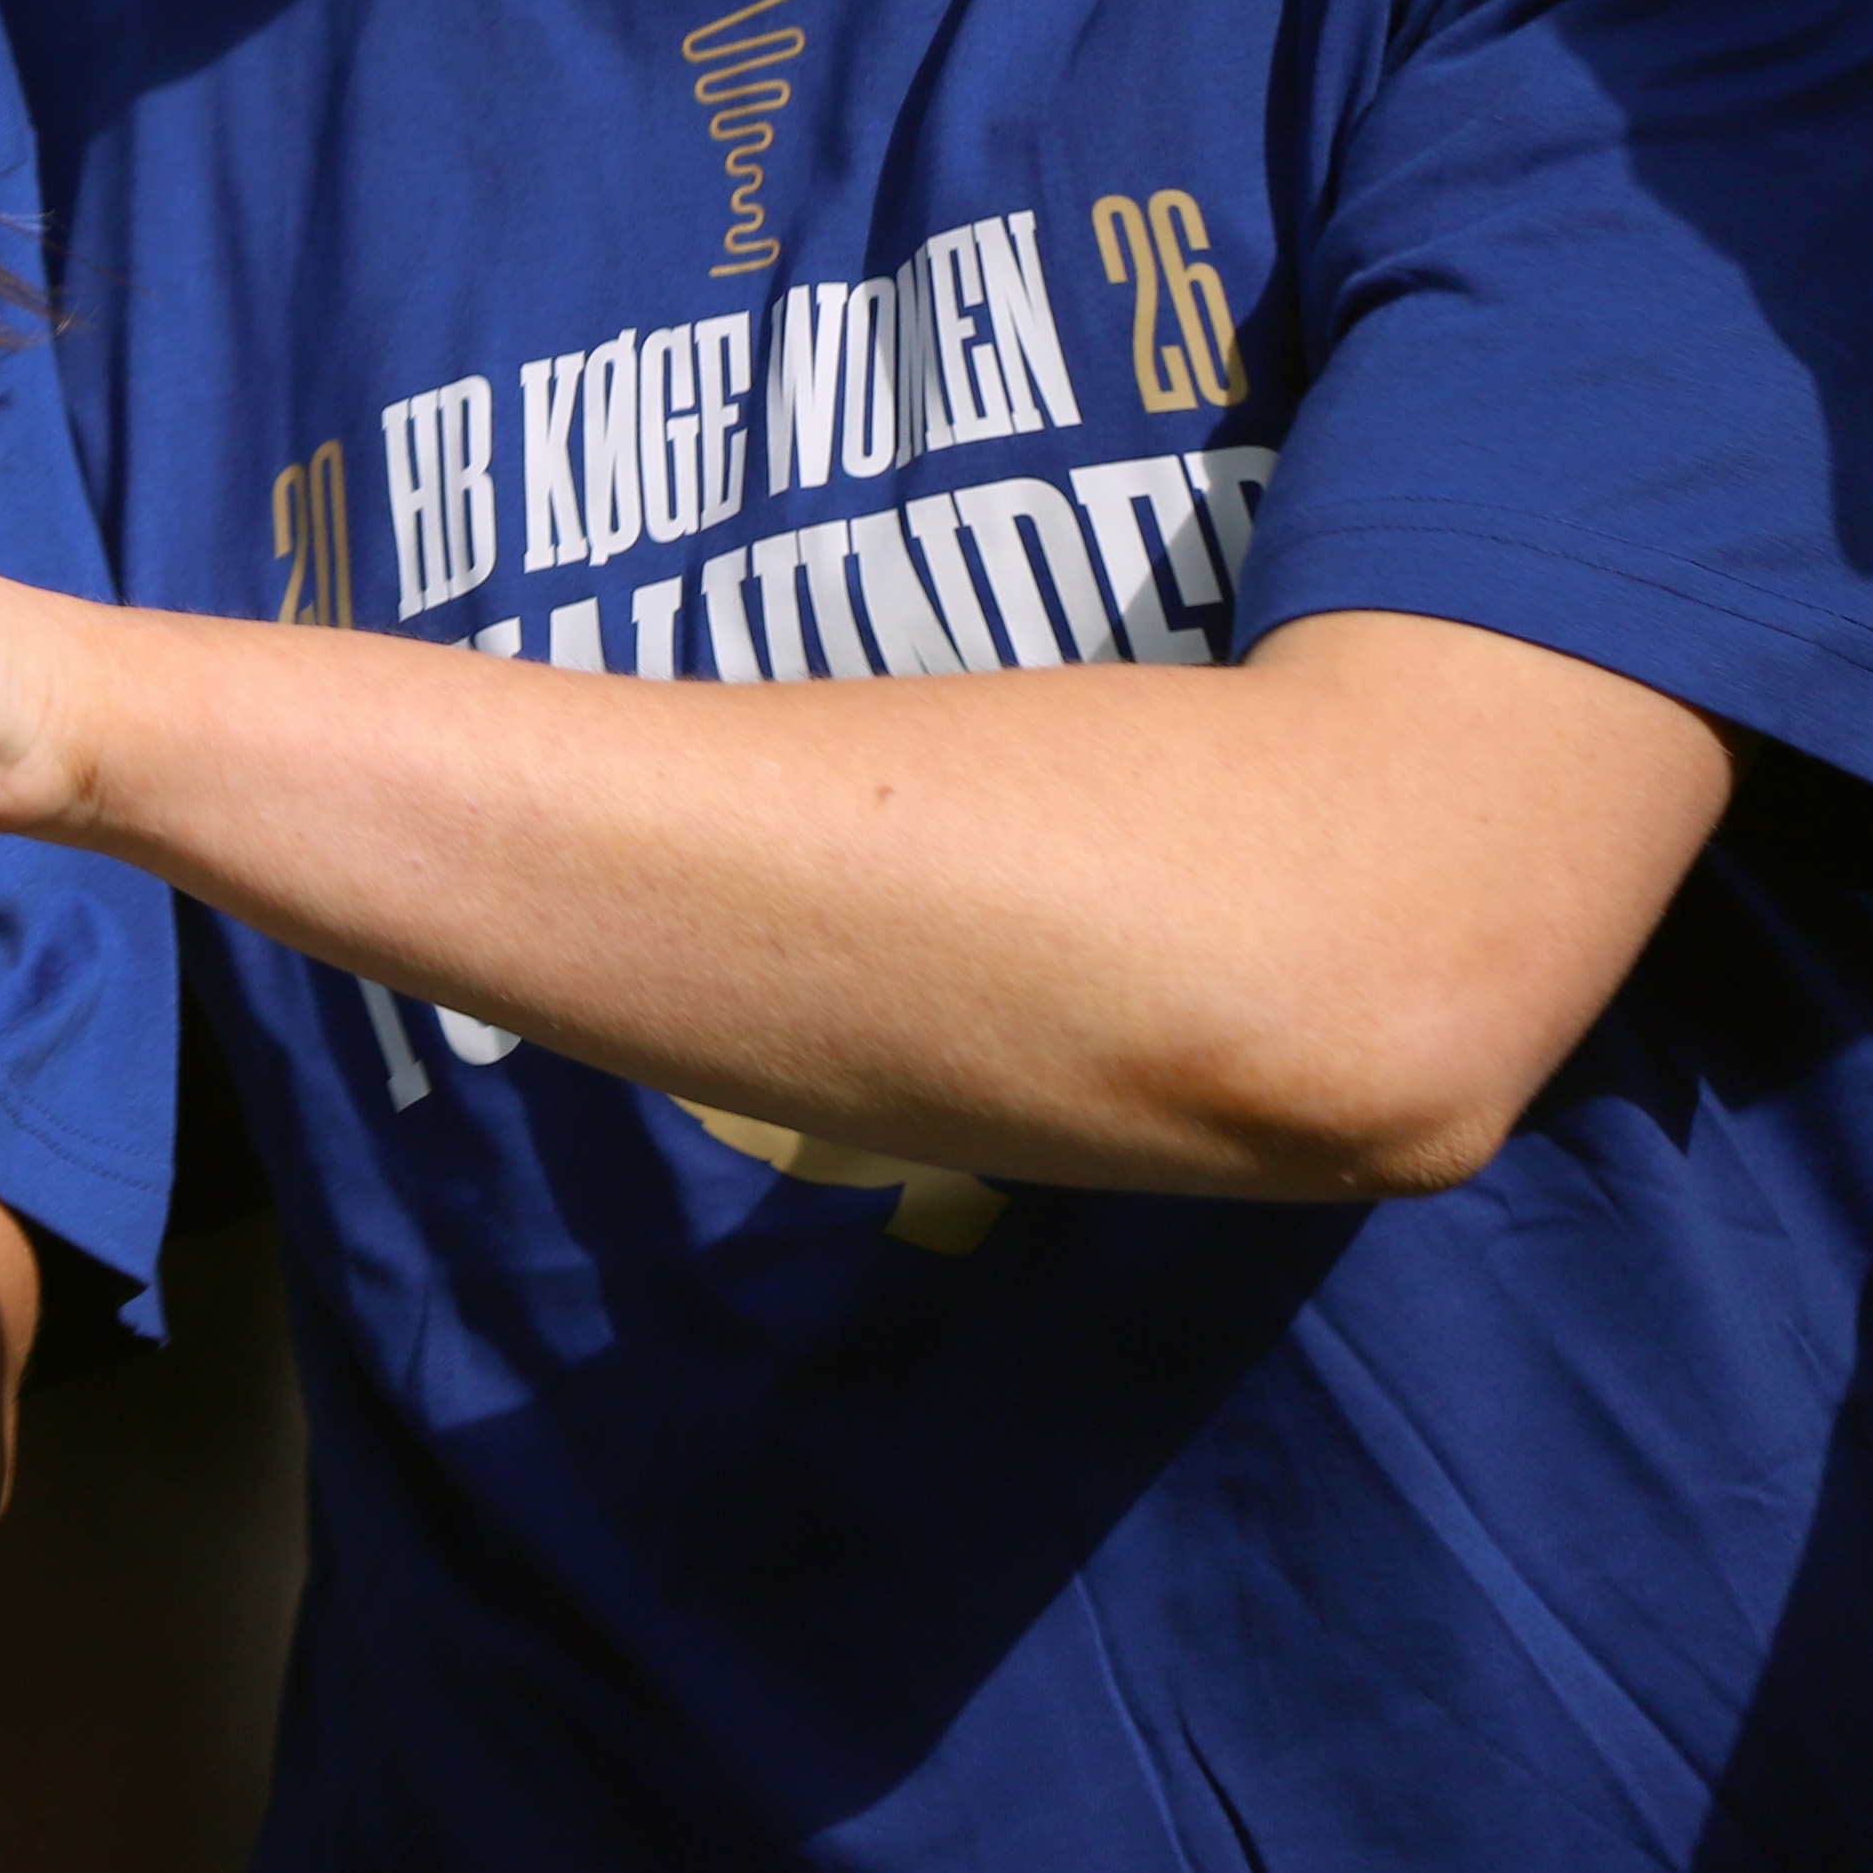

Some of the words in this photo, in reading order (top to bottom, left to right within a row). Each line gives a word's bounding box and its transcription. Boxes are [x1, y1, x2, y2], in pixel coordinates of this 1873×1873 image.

[272, 439, 351, 630] 20
[381, 375, 497, 623] HB
[520, 311, 751, 573] KØGE
[767, 210, 1083, 498] WOMEN
[1091, 189, 1248, 414] 26
